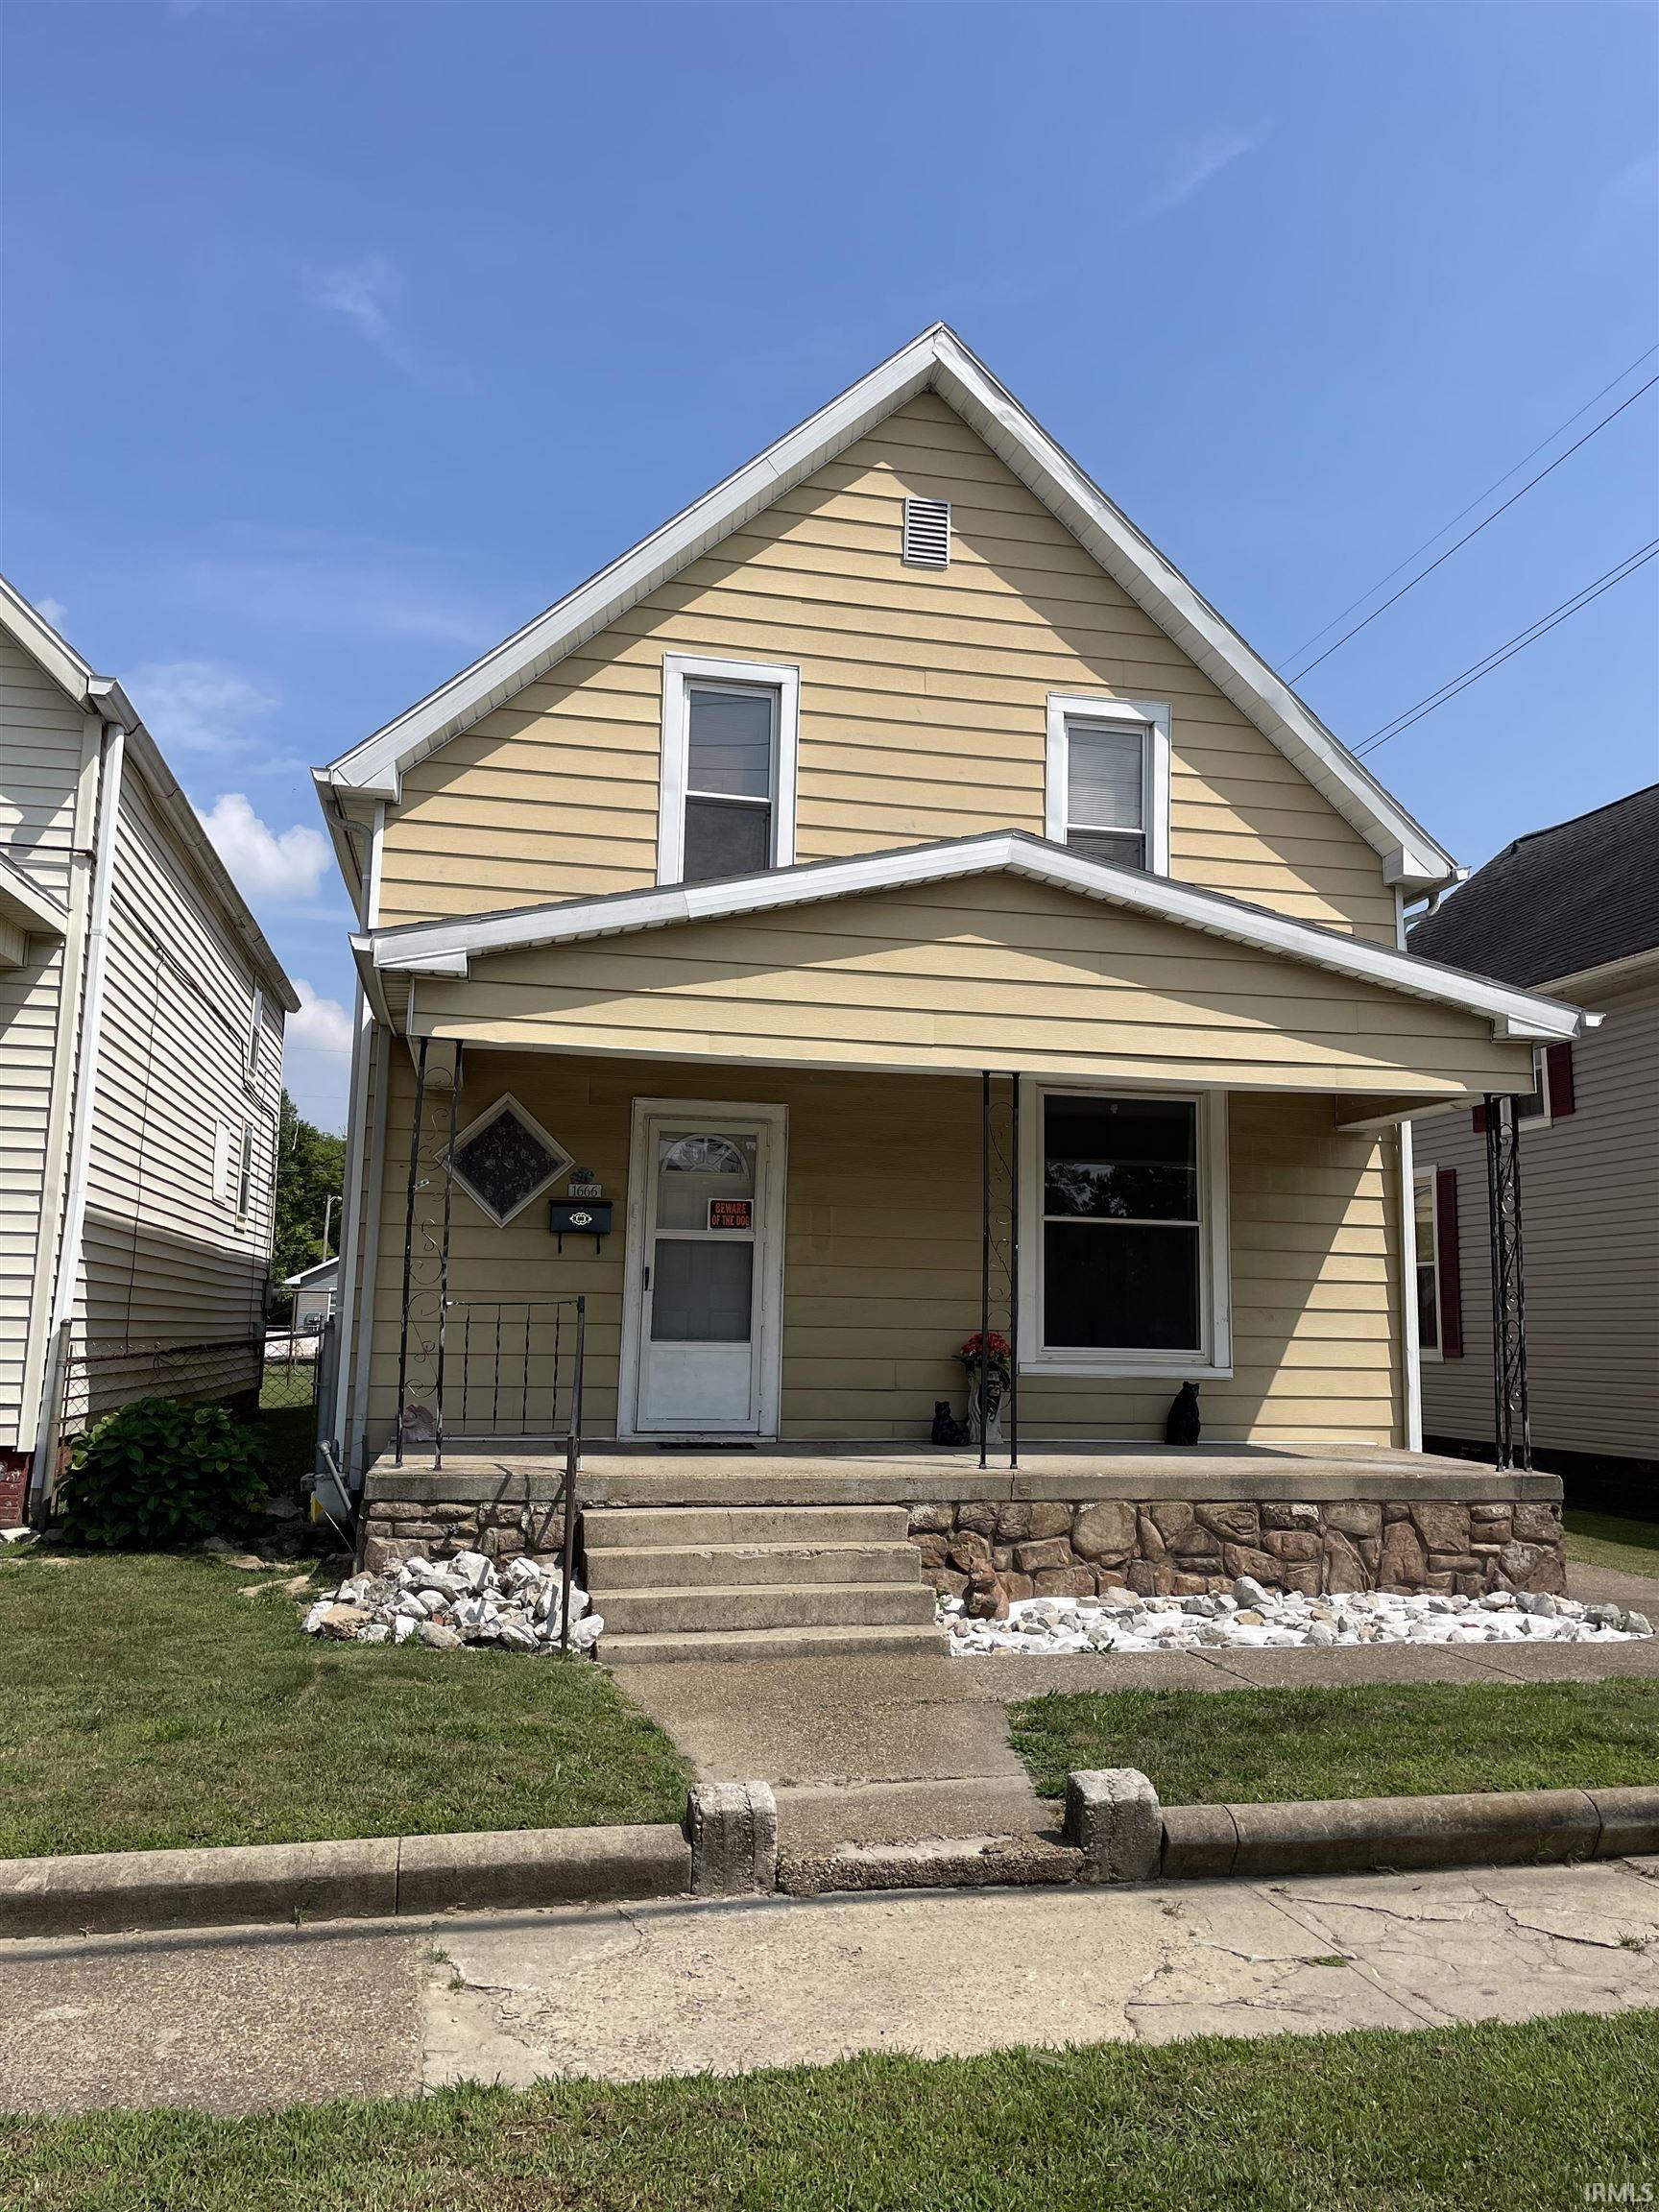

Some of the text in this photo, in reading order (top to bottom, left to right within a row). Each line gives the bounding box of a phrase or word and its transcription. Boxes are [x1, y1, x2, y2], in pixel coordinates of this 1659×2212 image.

[573, 1185, 598, 1197] 1666
[715, 1202, 747, 1214] BEWARE
[711, 1214, 750, 1226] OF THE DOG
